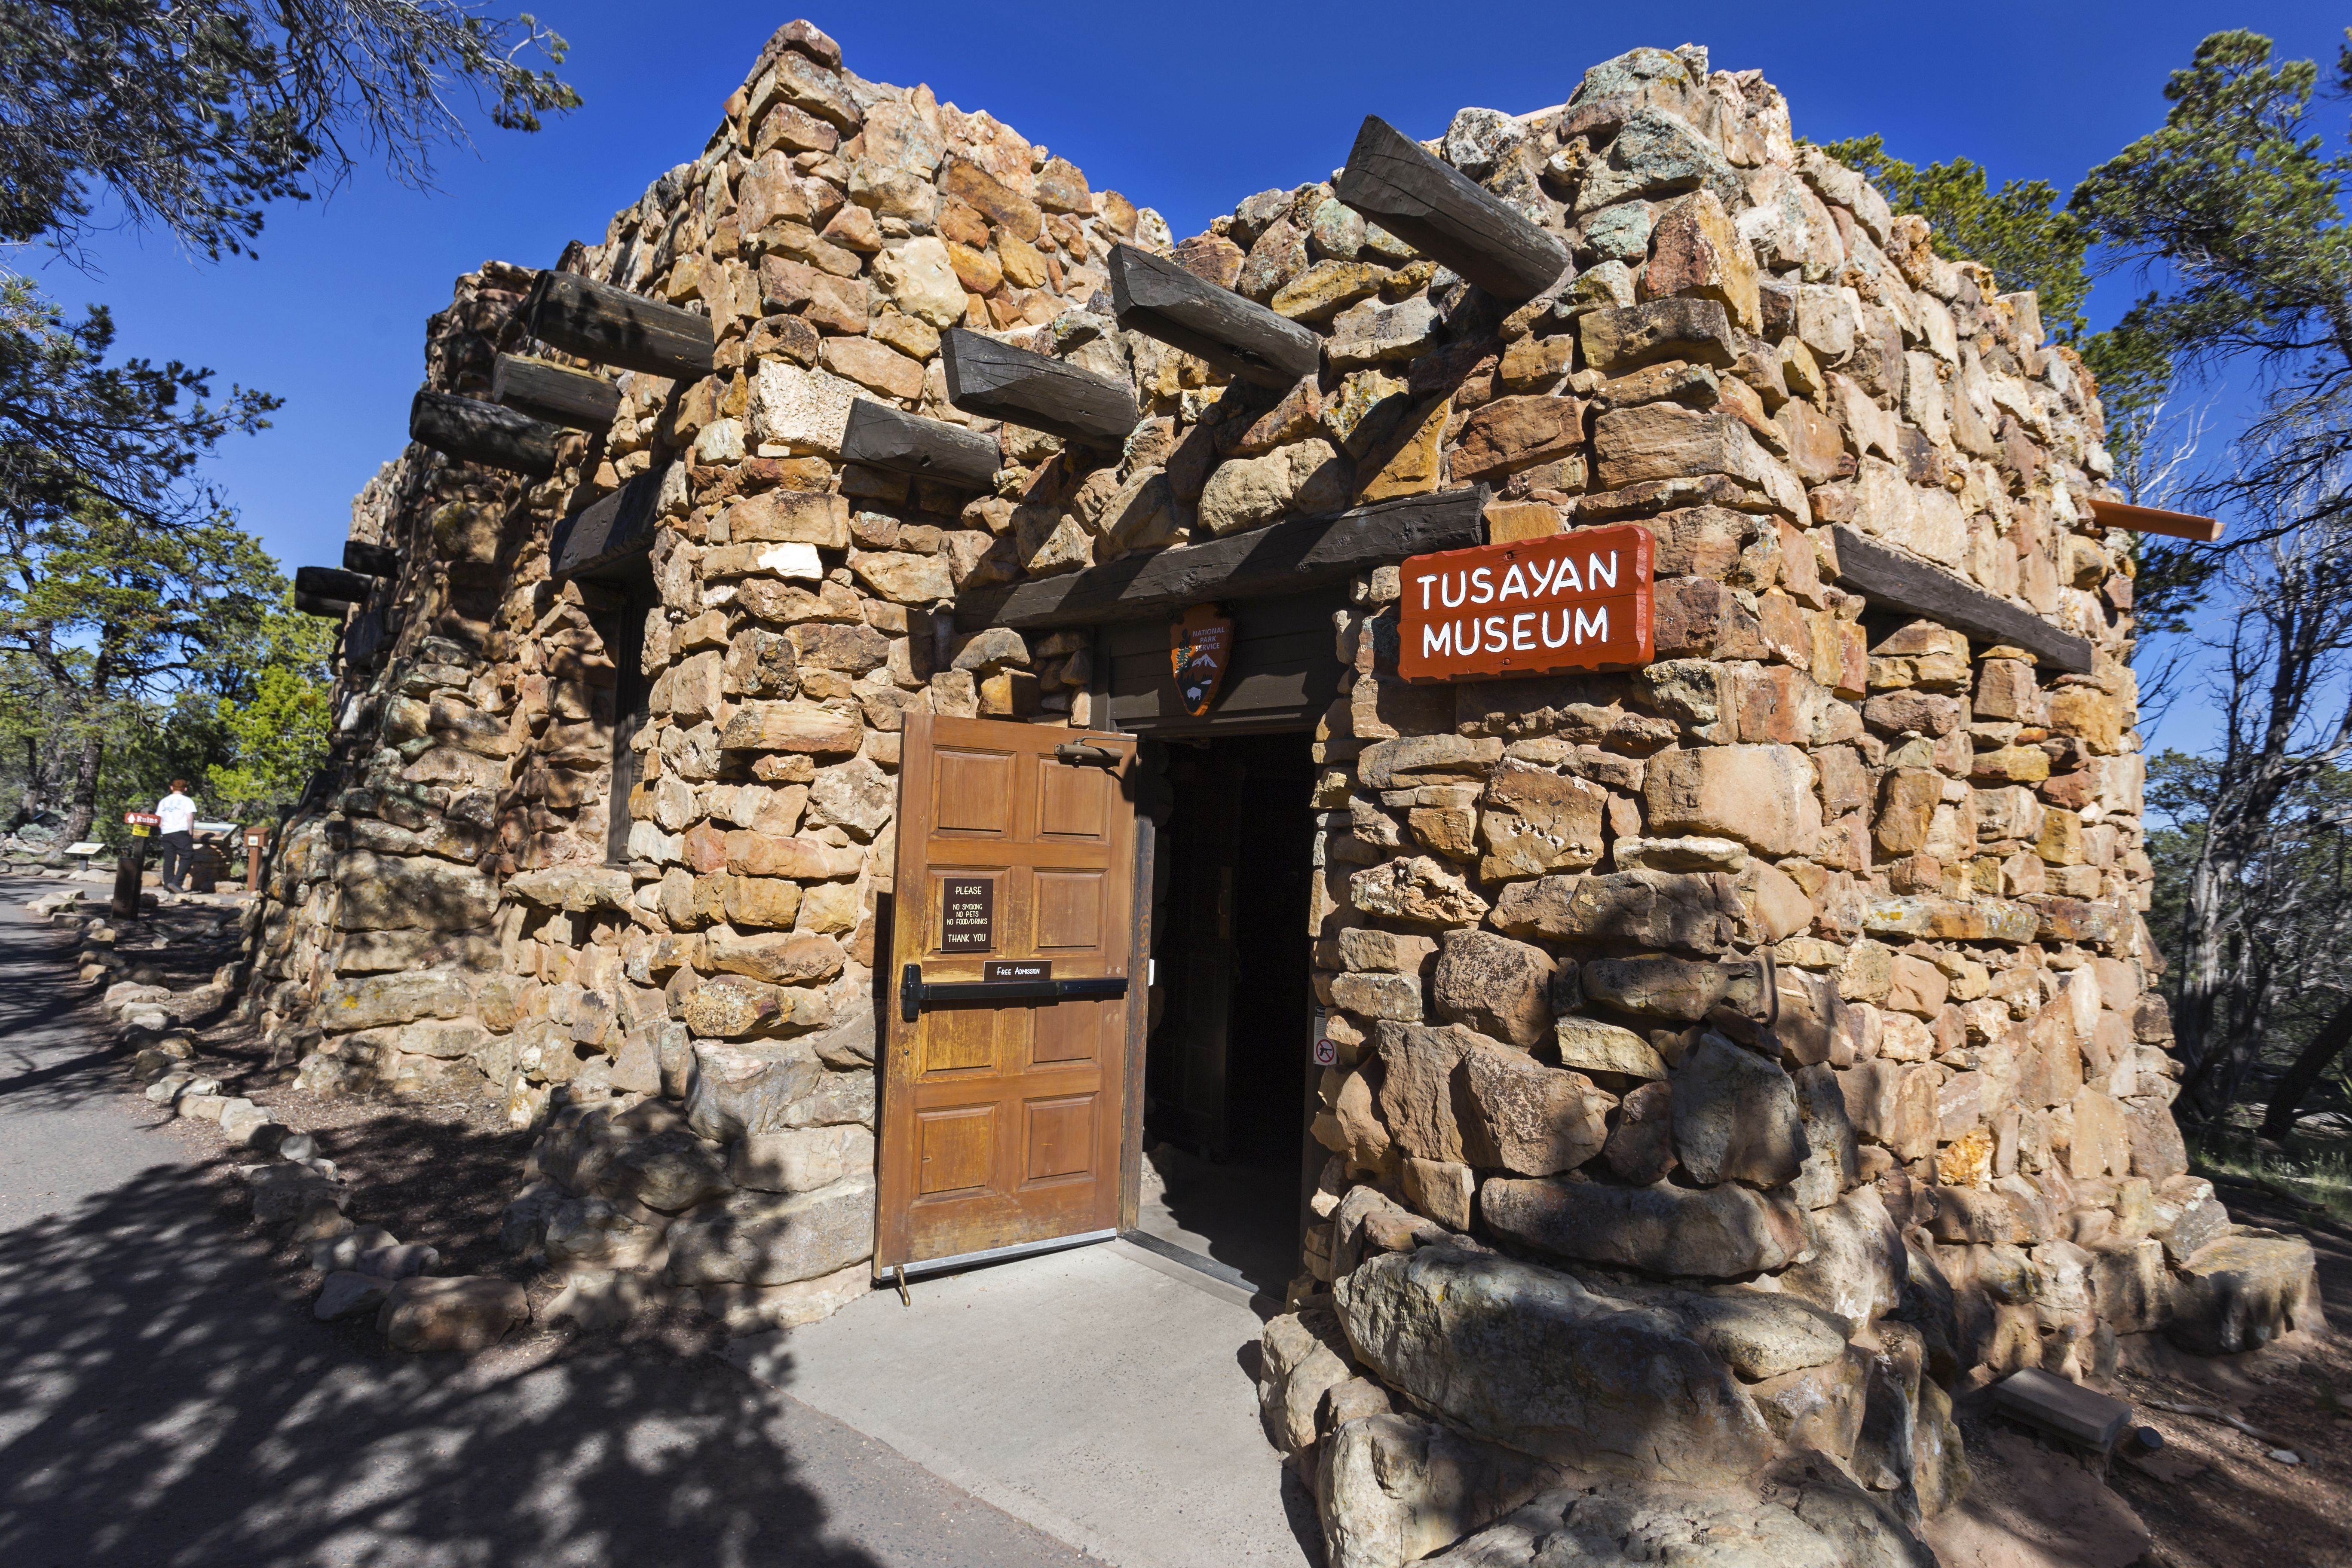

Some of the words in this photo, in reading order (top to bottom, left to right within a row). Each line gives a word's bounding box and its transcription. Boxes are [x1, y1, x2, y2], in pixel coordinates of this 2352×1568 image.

[1417, 549, 1618, 611] TUSAYAN
[1193, 627, 1225, 637] NATIONAL
[1423, 605, 1610, 659] MUSEUM
[1200, 635, 1216, 643] PARK
[1195, 643, 1220, 652] SERVICE
[137, 815, 158, 824] Ruins
[955, 886, 982, 895] PLEASE
[948, 934, 970, 943] THANK
[973, 933, 986, 942] YOU
